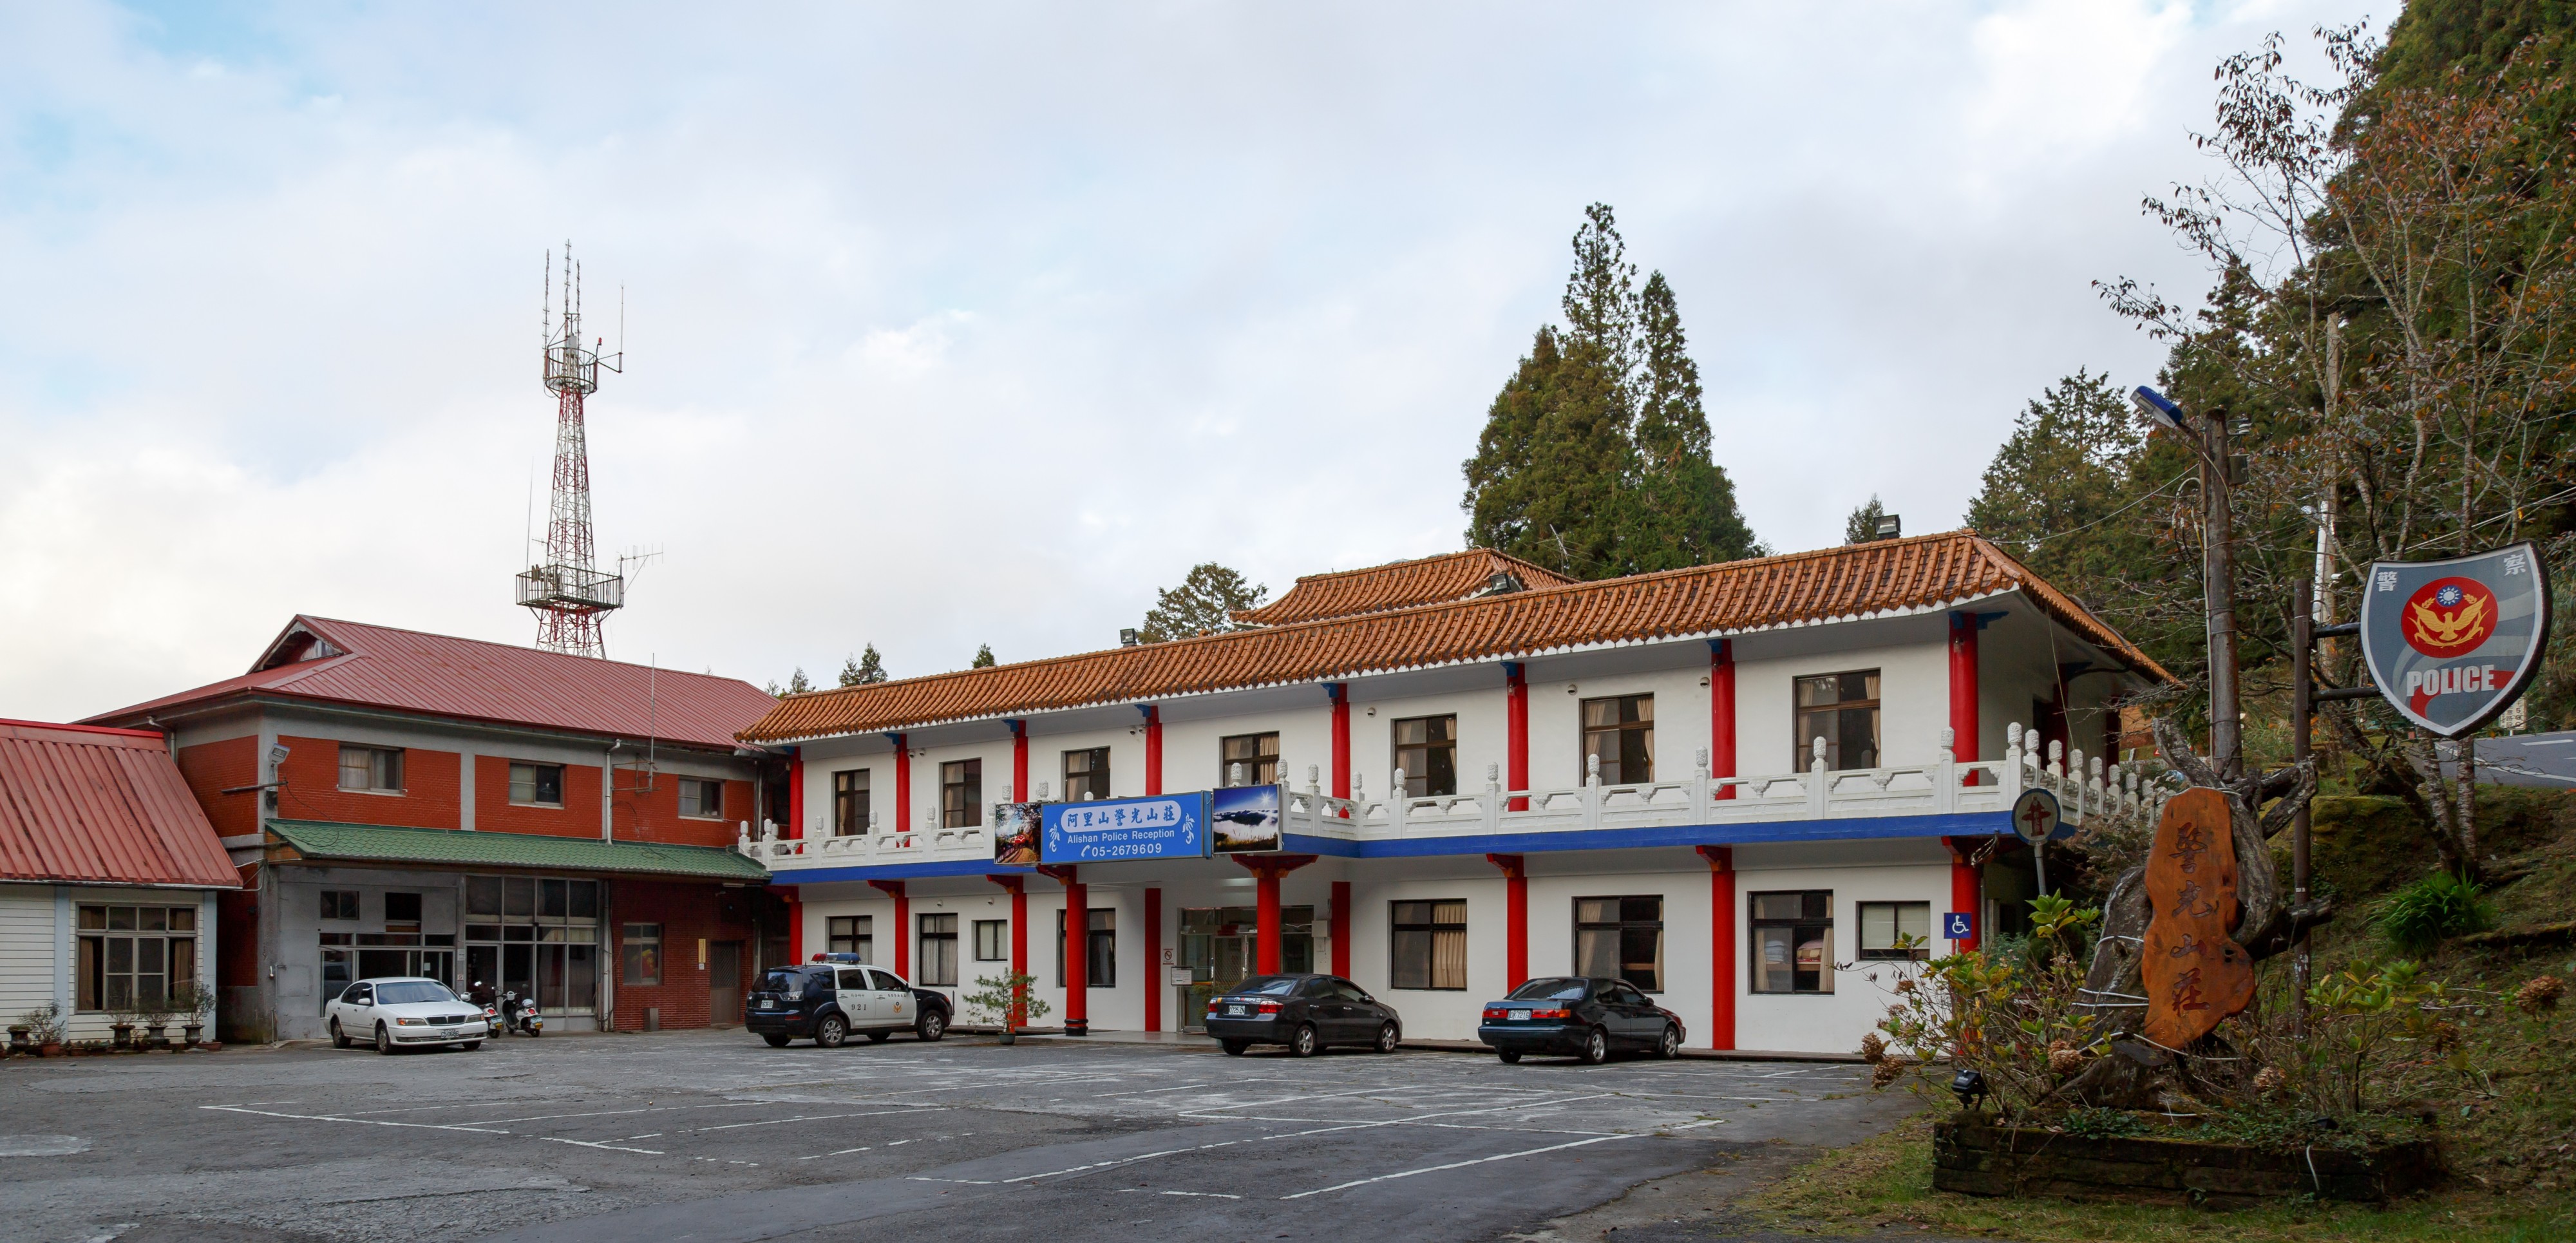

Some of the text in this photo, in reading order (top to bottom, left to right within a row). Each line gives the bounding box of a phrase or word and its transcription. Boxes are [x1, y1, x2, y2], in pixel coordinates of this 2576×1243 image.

[2377, 554, 2526, 592] 警 察
[2406, 664, 2494, 697] POLICE
[1067, 804, 1175, 828] 阿里山警光山莊
[1067, 829, 1175, 844] Alishan Police Reception
[1092, 843, 1162, 857] 05-2679609
